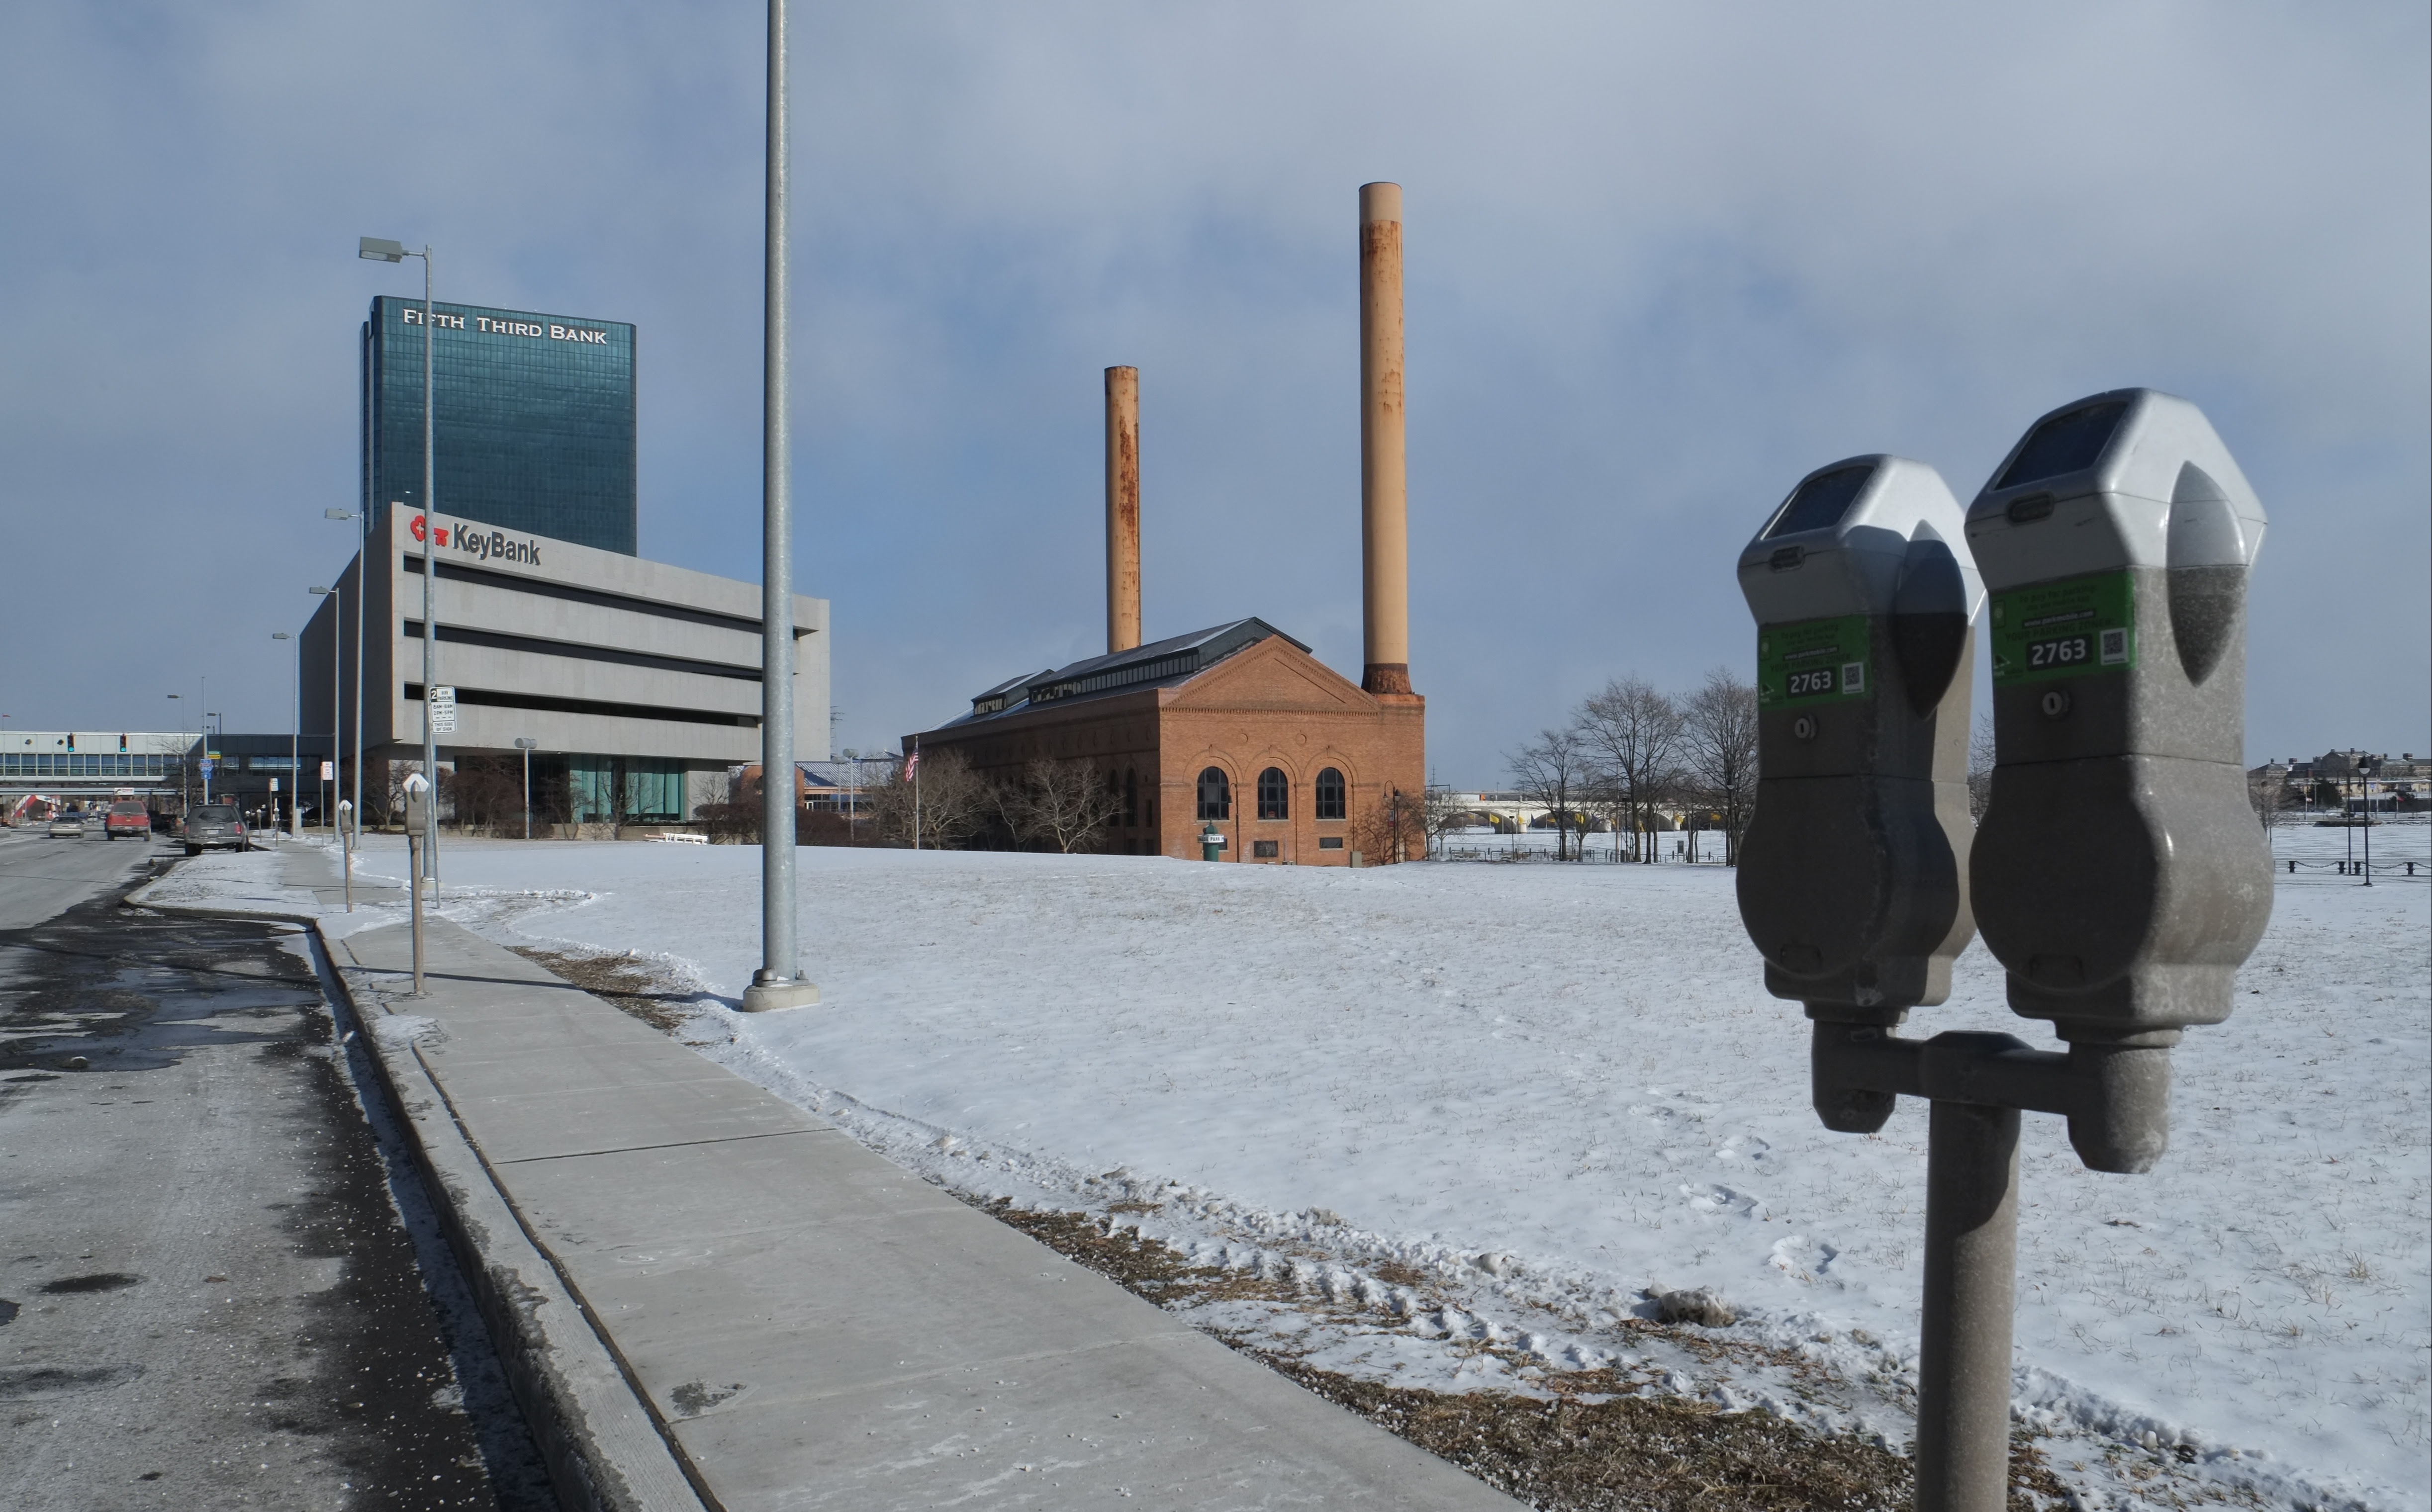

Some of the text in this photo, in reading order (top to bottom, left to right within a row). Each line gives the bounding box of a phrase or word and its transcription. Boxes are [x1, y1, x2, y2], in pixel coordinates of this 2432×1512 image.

[476, 317, 542, 337] THIRD
[550, 325, 607, 345] BANK
[453, 523, 541, 566] KeyBank
[2024, 611, 2094, 627] www.parkmobile.com
[2005, 630, 2030, 641] YOUR
[2033, 623, 2076, 637] PARKING
[2032, 638, 2086, 665] 2763
[1790, 671, 1832, 694] 2763
[431, 690, 437, 700] 2
